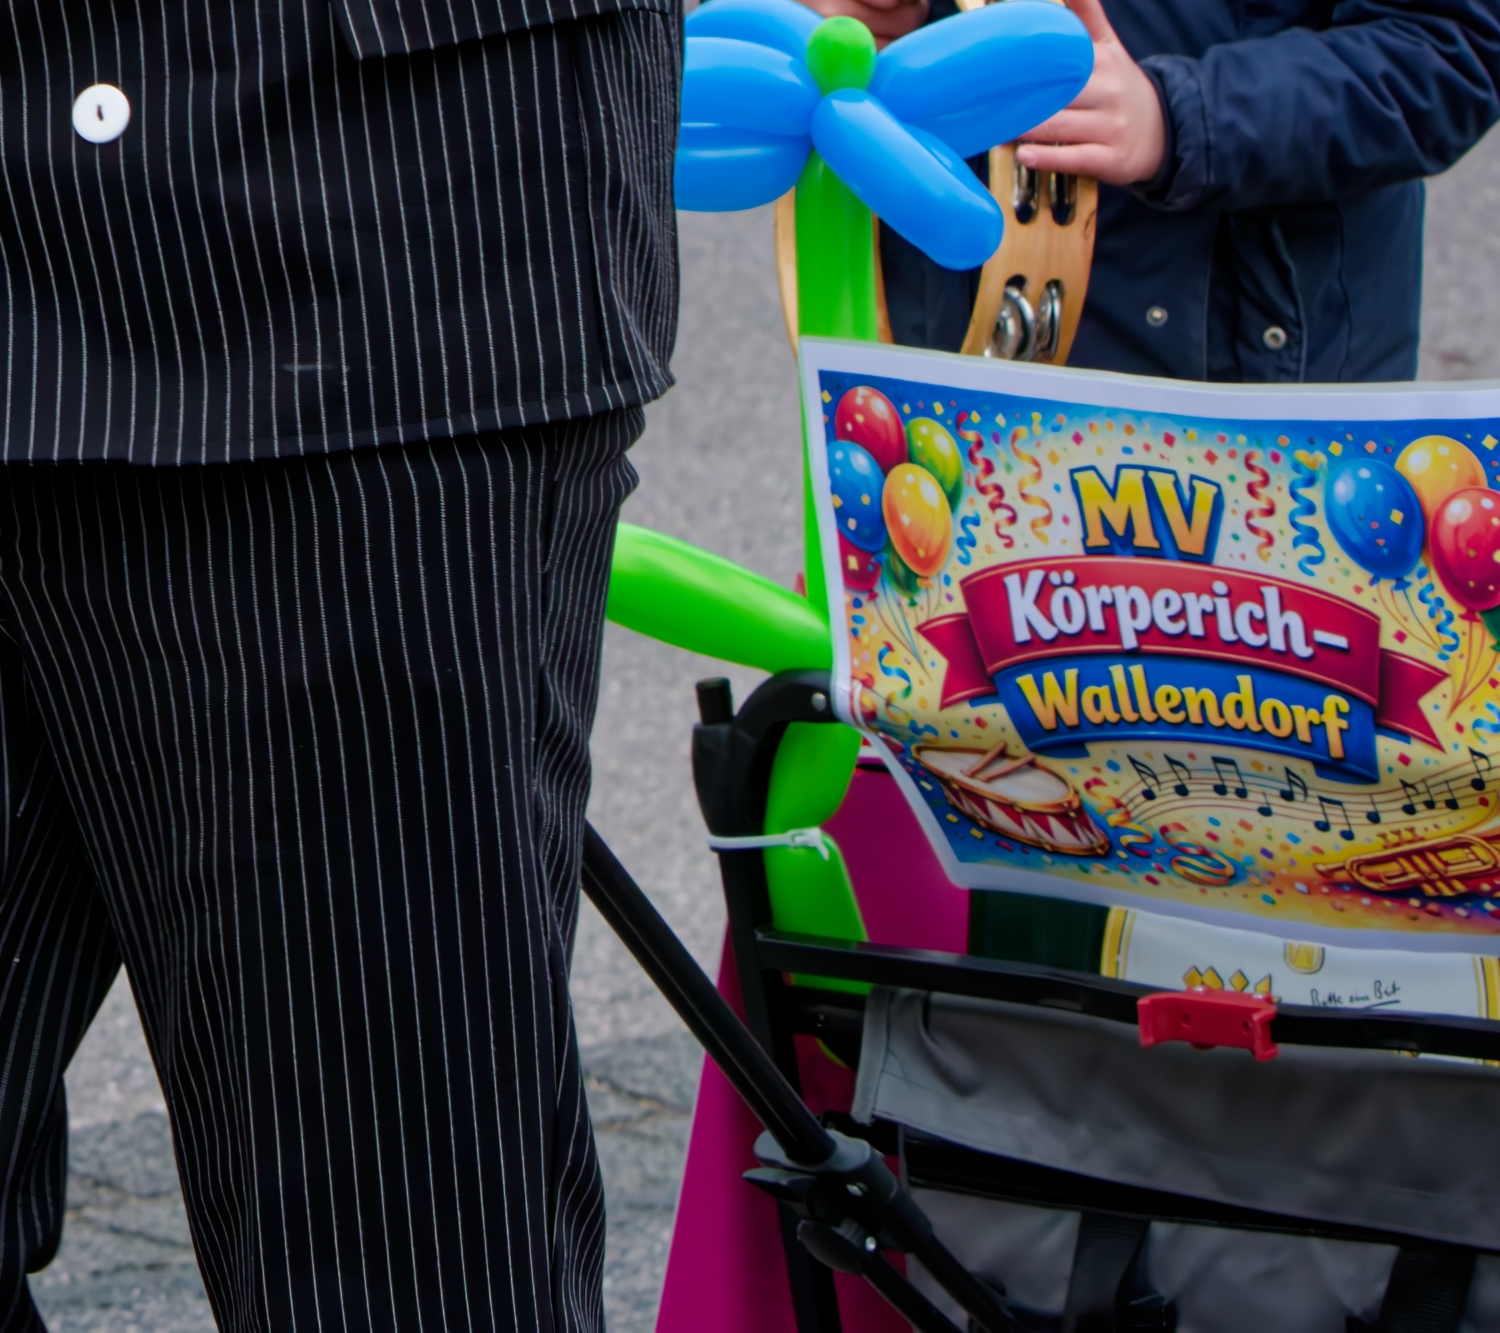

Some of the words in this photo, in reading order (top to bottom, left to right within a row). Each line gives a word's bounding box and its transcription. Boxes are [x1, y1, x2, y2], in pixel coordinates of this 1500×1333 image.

[1071, 465, 1222, 560] MV
[1003, 569, 1350, 658] Körperich-
[1016, 663, 1350, 759] Wallendorf
